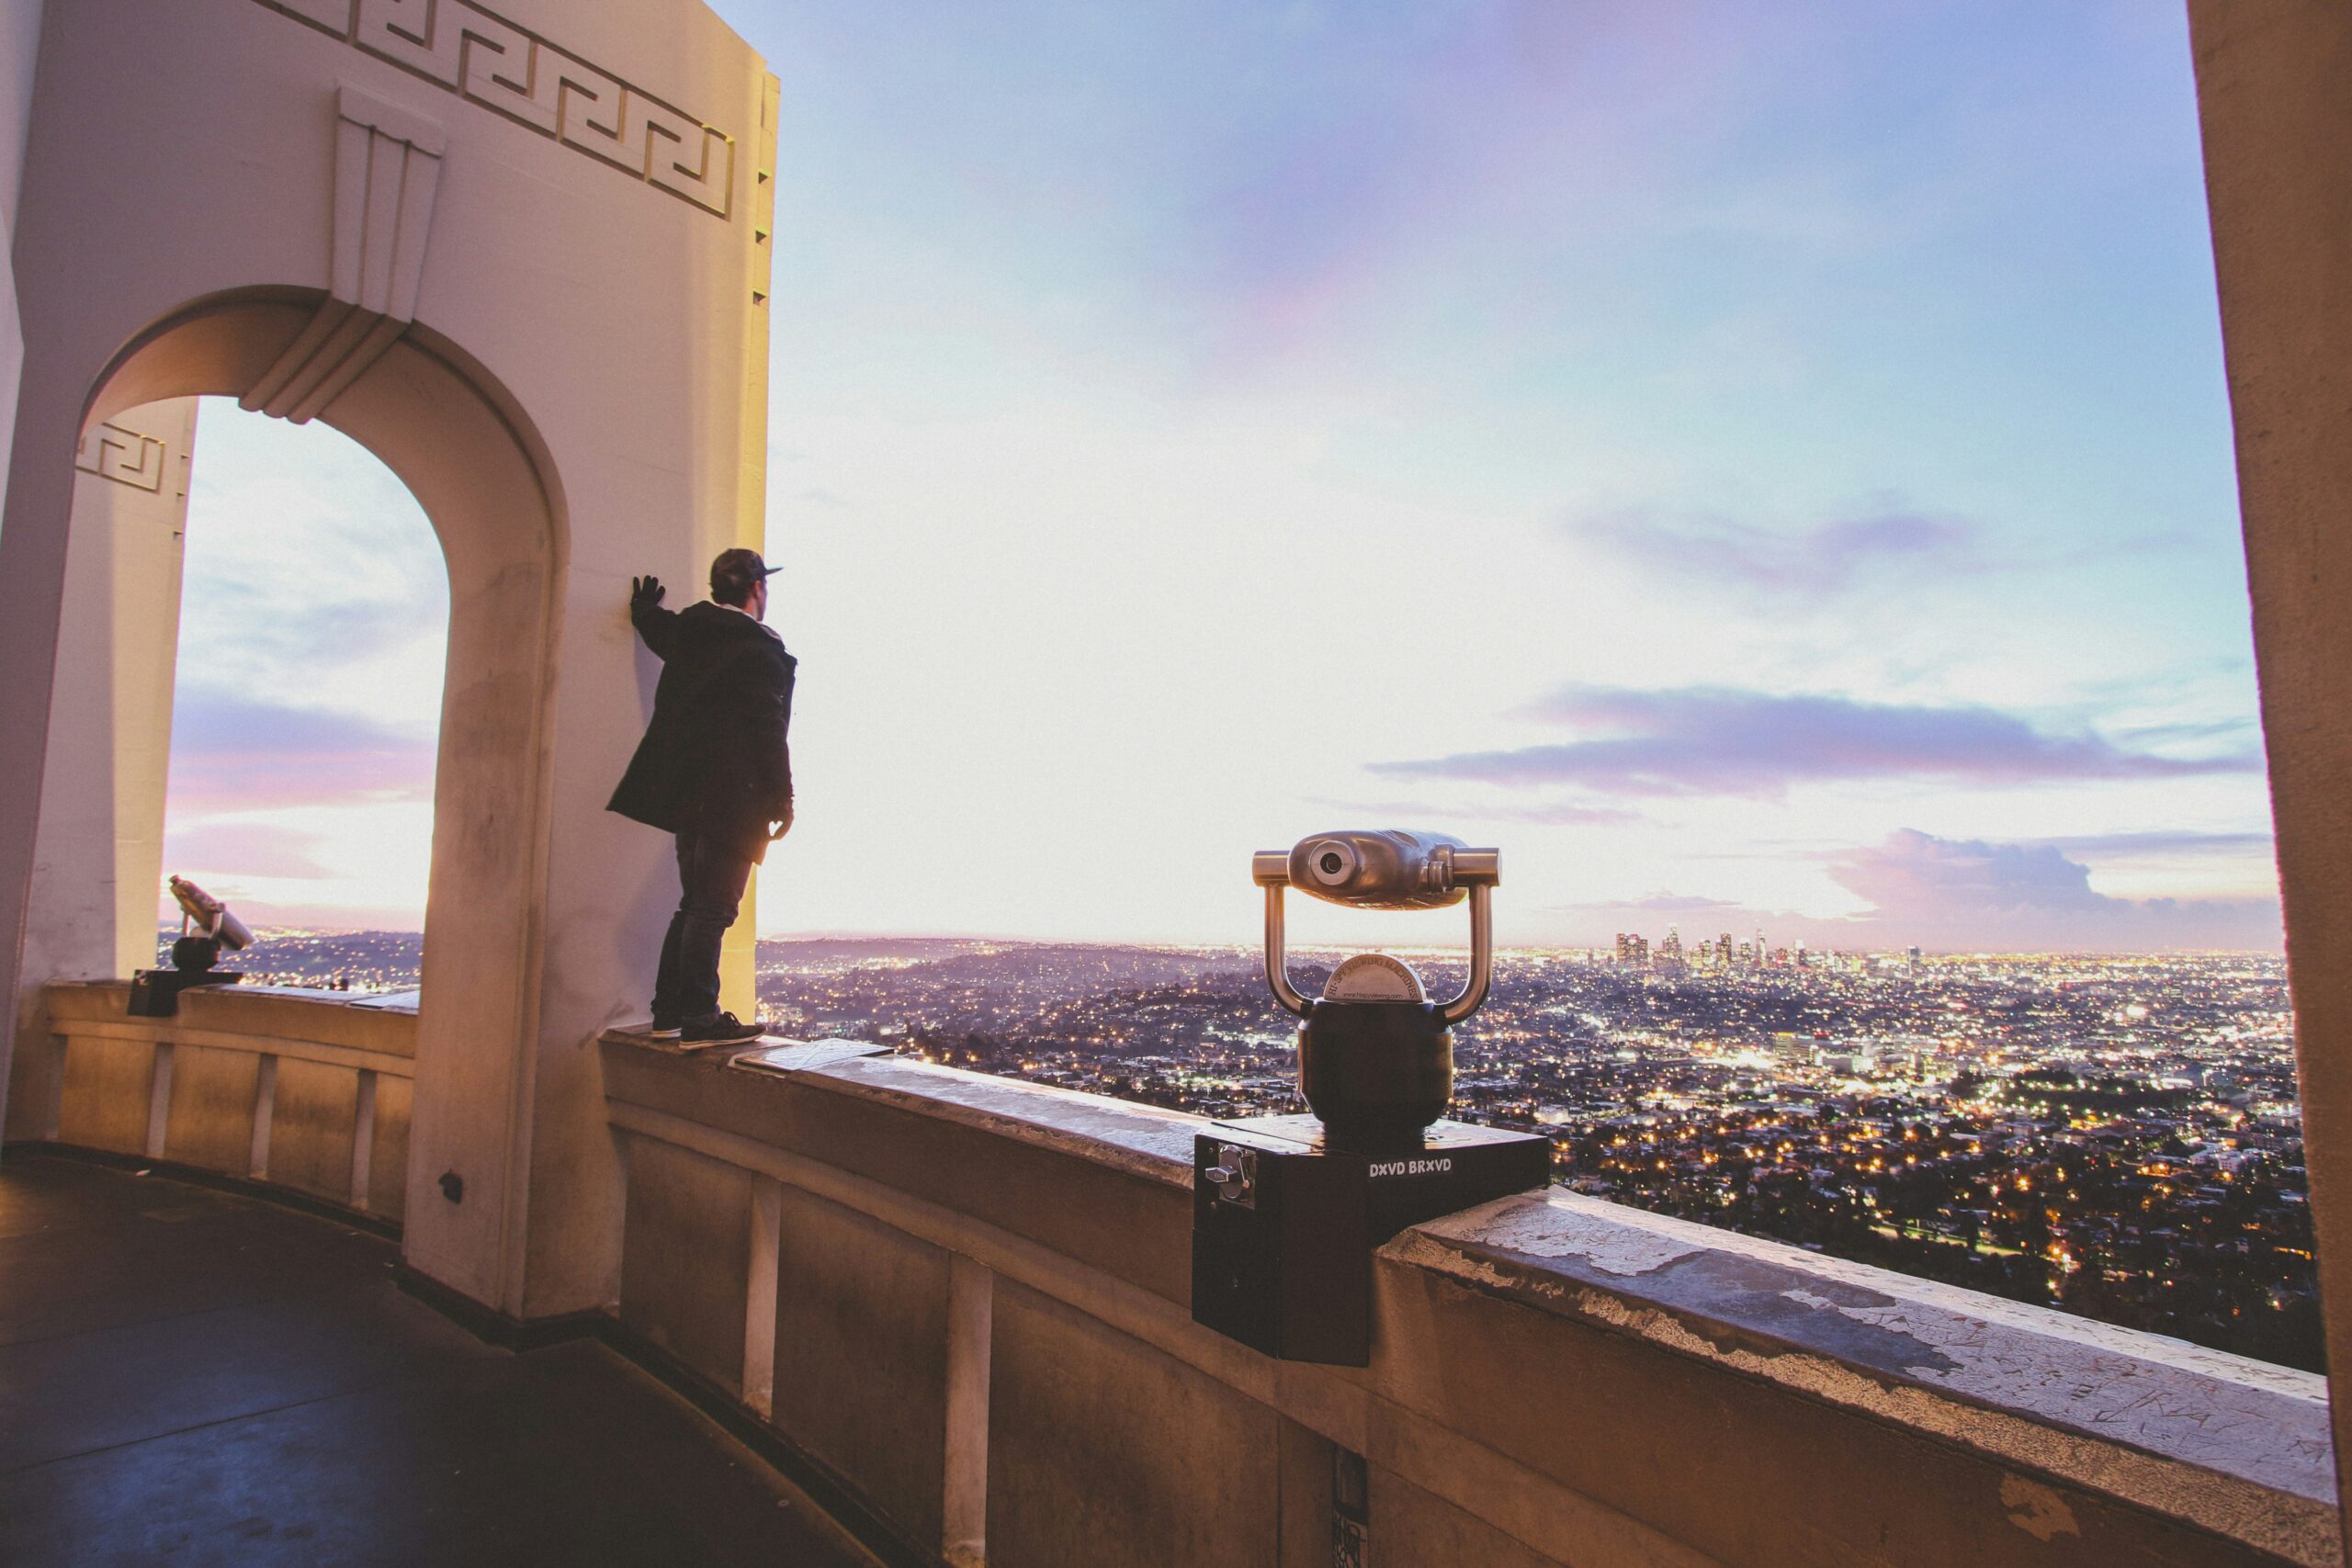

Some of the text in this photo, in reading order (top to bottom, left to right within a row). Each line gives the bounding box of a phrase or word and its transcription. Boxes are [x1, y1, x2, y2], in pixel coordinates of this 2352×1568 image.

[1329, 957, 1418, 998] HI-SPY VIEWING MACHINES
[1370, 1158, 1452, 1177] DXVD BRXVD
